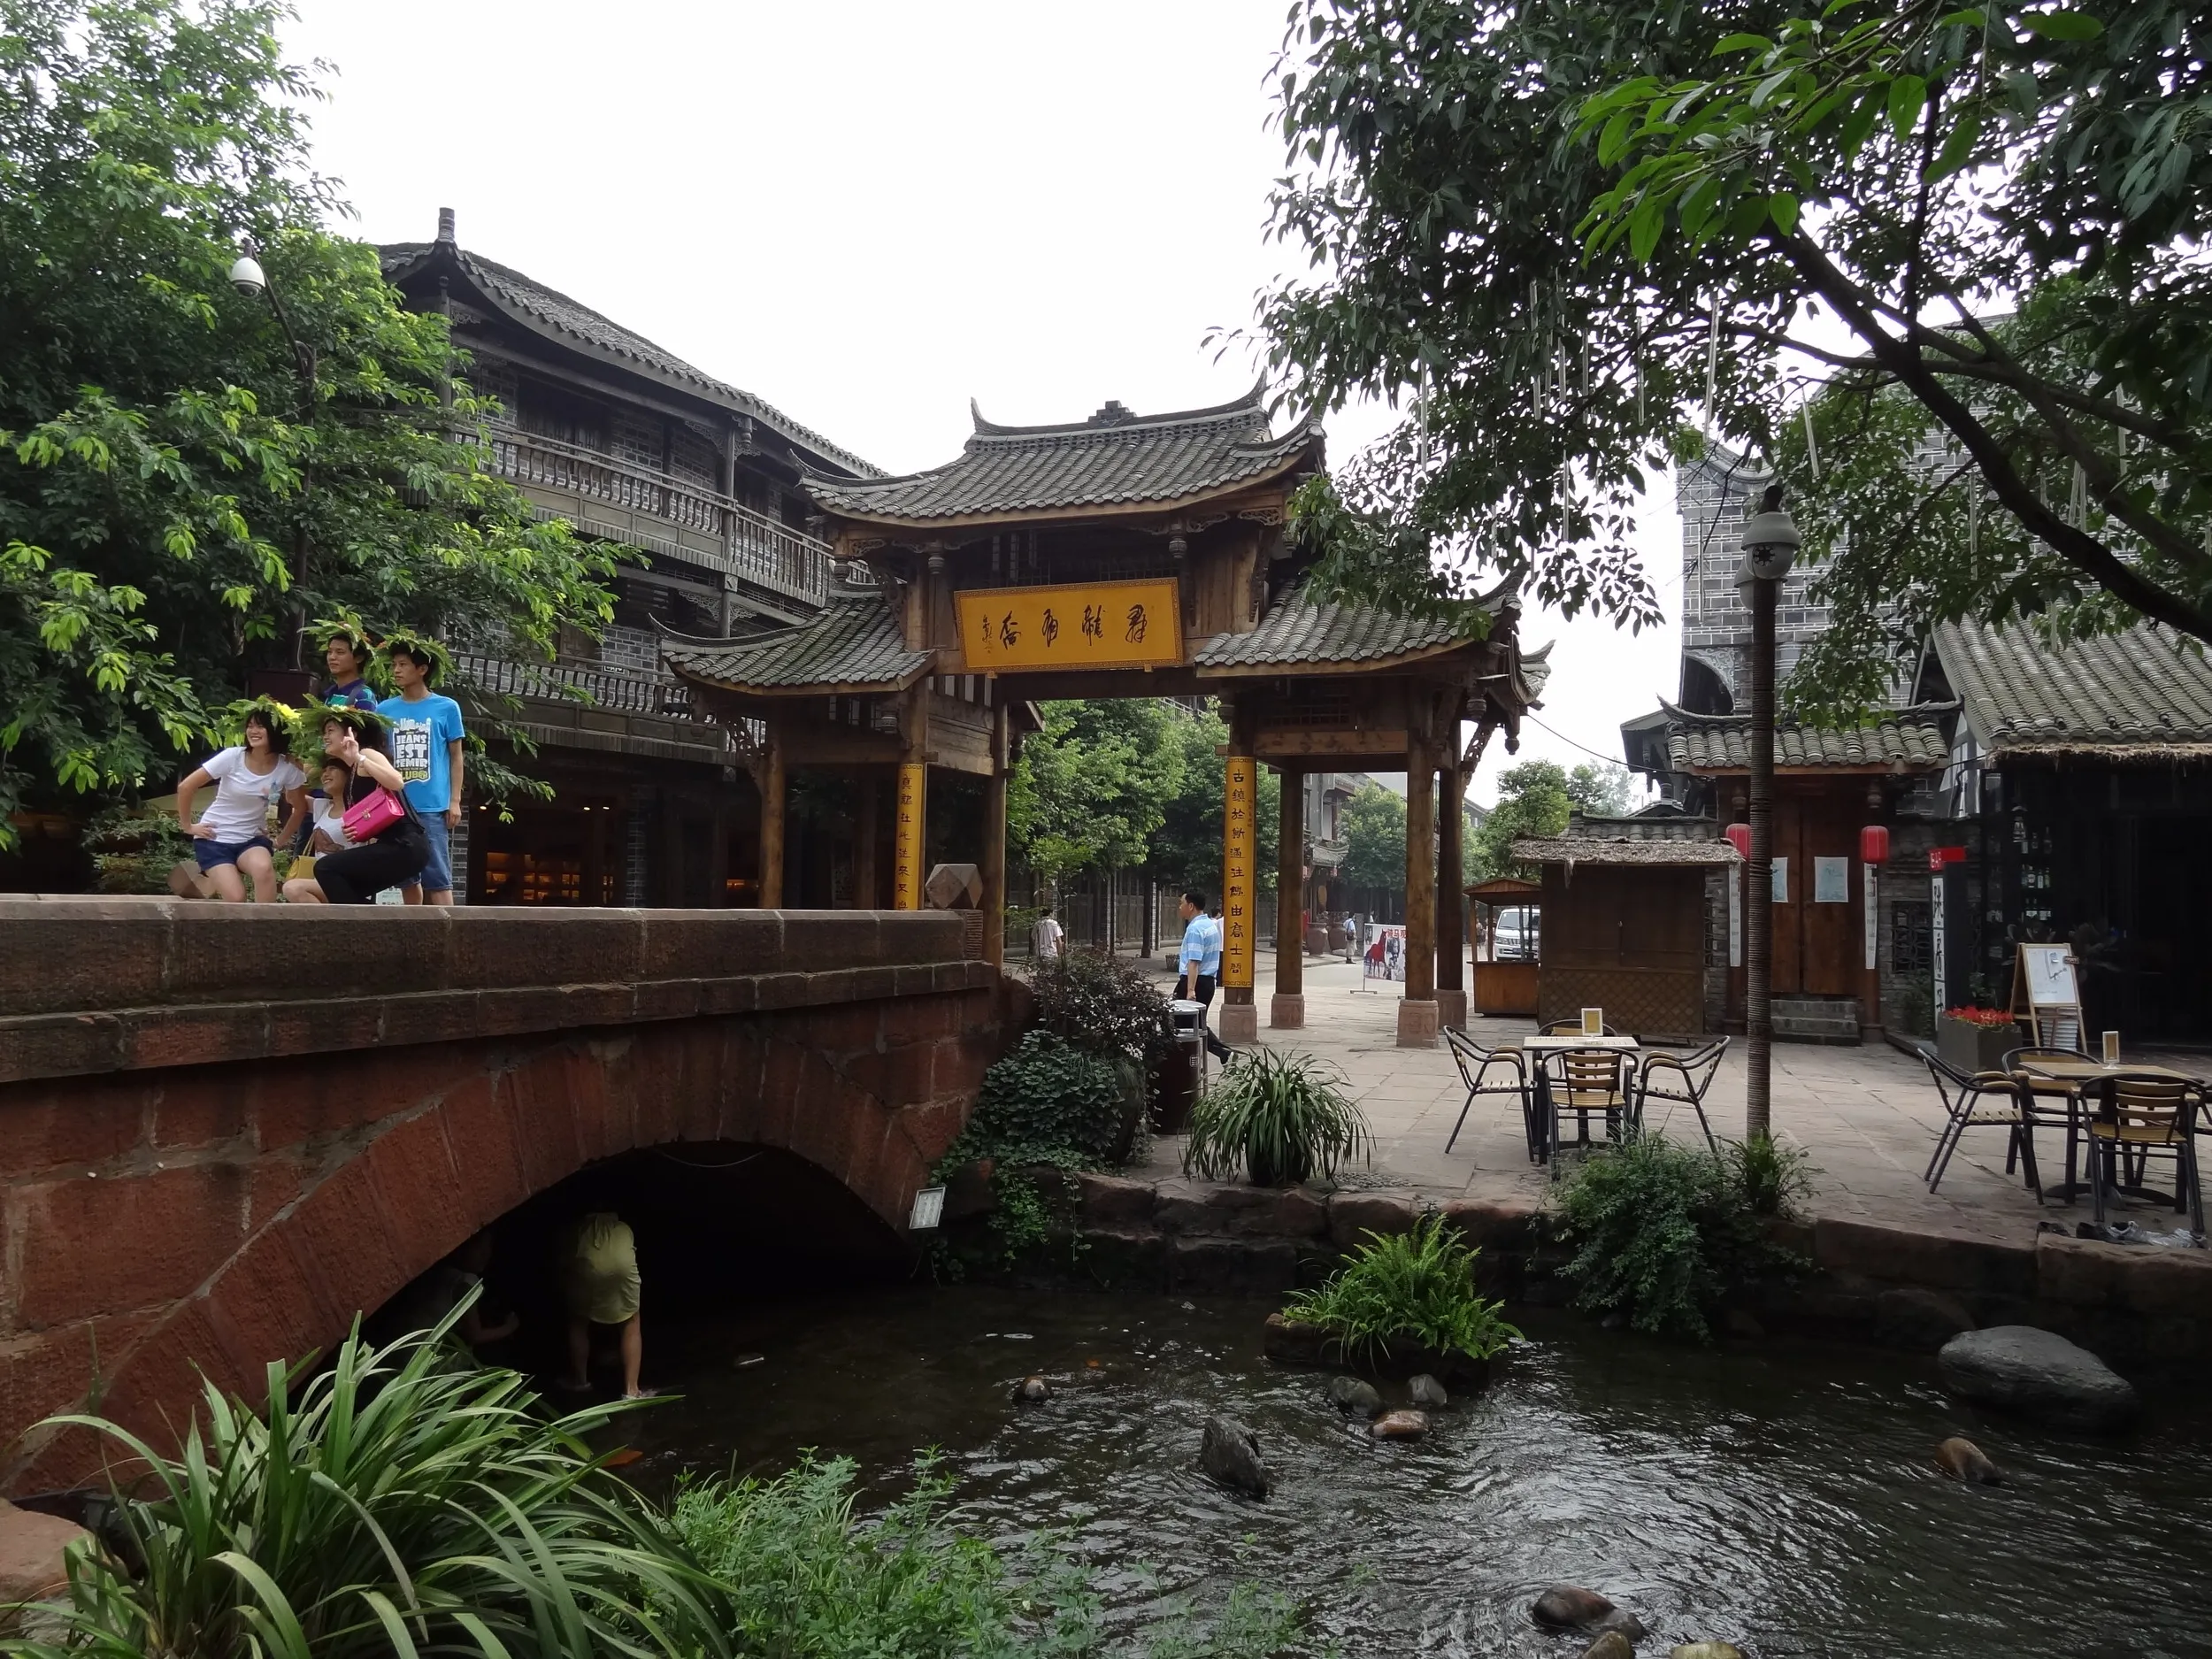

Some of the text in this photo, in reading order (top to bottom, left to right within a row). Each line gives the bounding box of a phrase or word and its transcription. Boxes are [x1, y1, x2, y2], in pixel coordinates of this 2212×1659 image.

[396, 734, 426, 744] JEANS
[396, 744, 427, 758] EST
[396, 758, 428, 768] SEMIR
